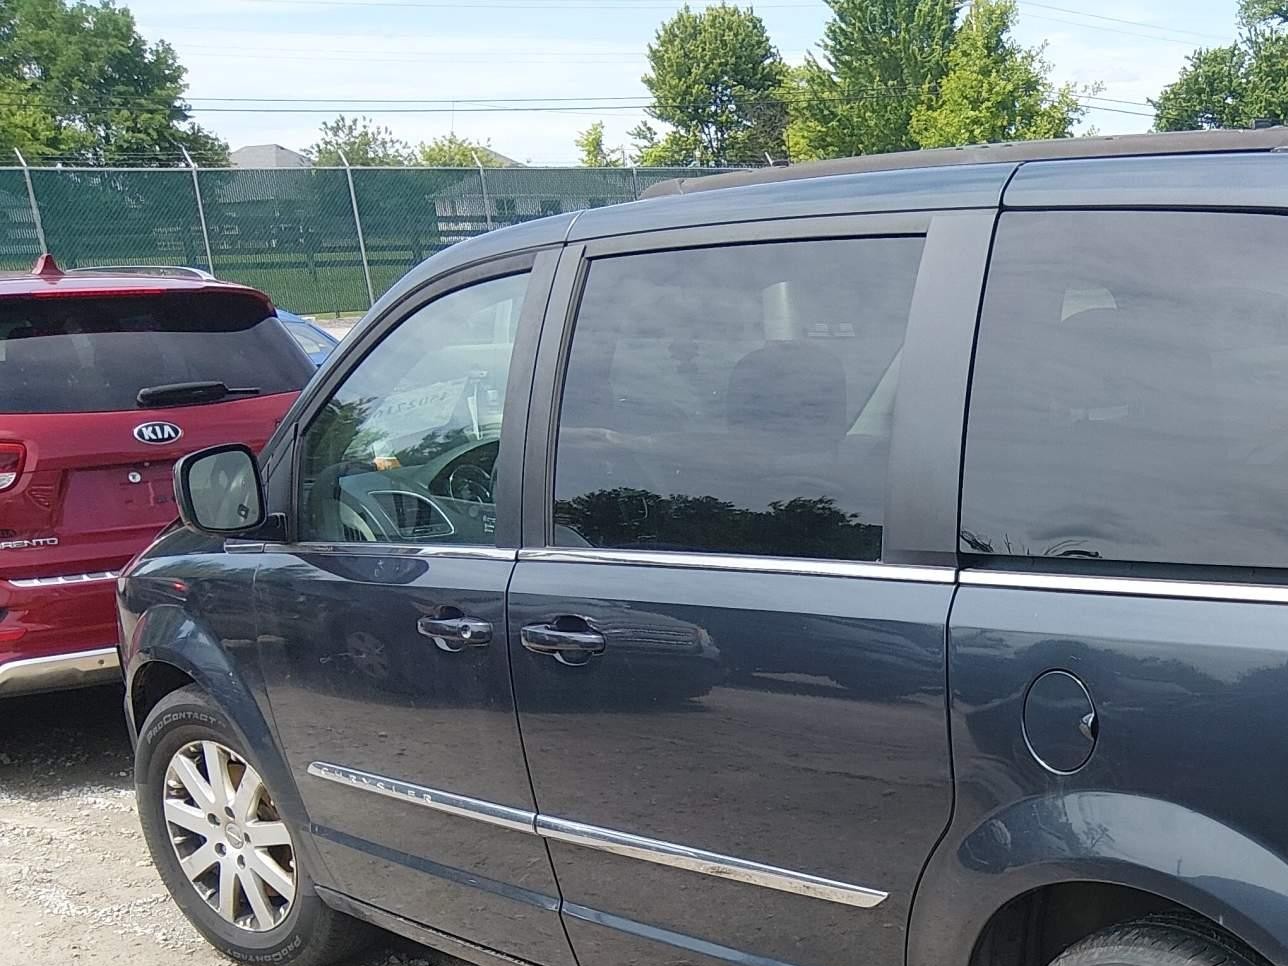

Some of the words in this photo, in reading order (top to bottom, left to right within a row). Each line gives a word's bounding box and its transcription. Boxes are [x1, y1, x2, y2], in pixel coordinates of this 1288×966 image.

[141, 425, 176, 440] KIA
[0, 537, 59, 550] RENTO
[320, 767, 432, 804] CHRYSLER
